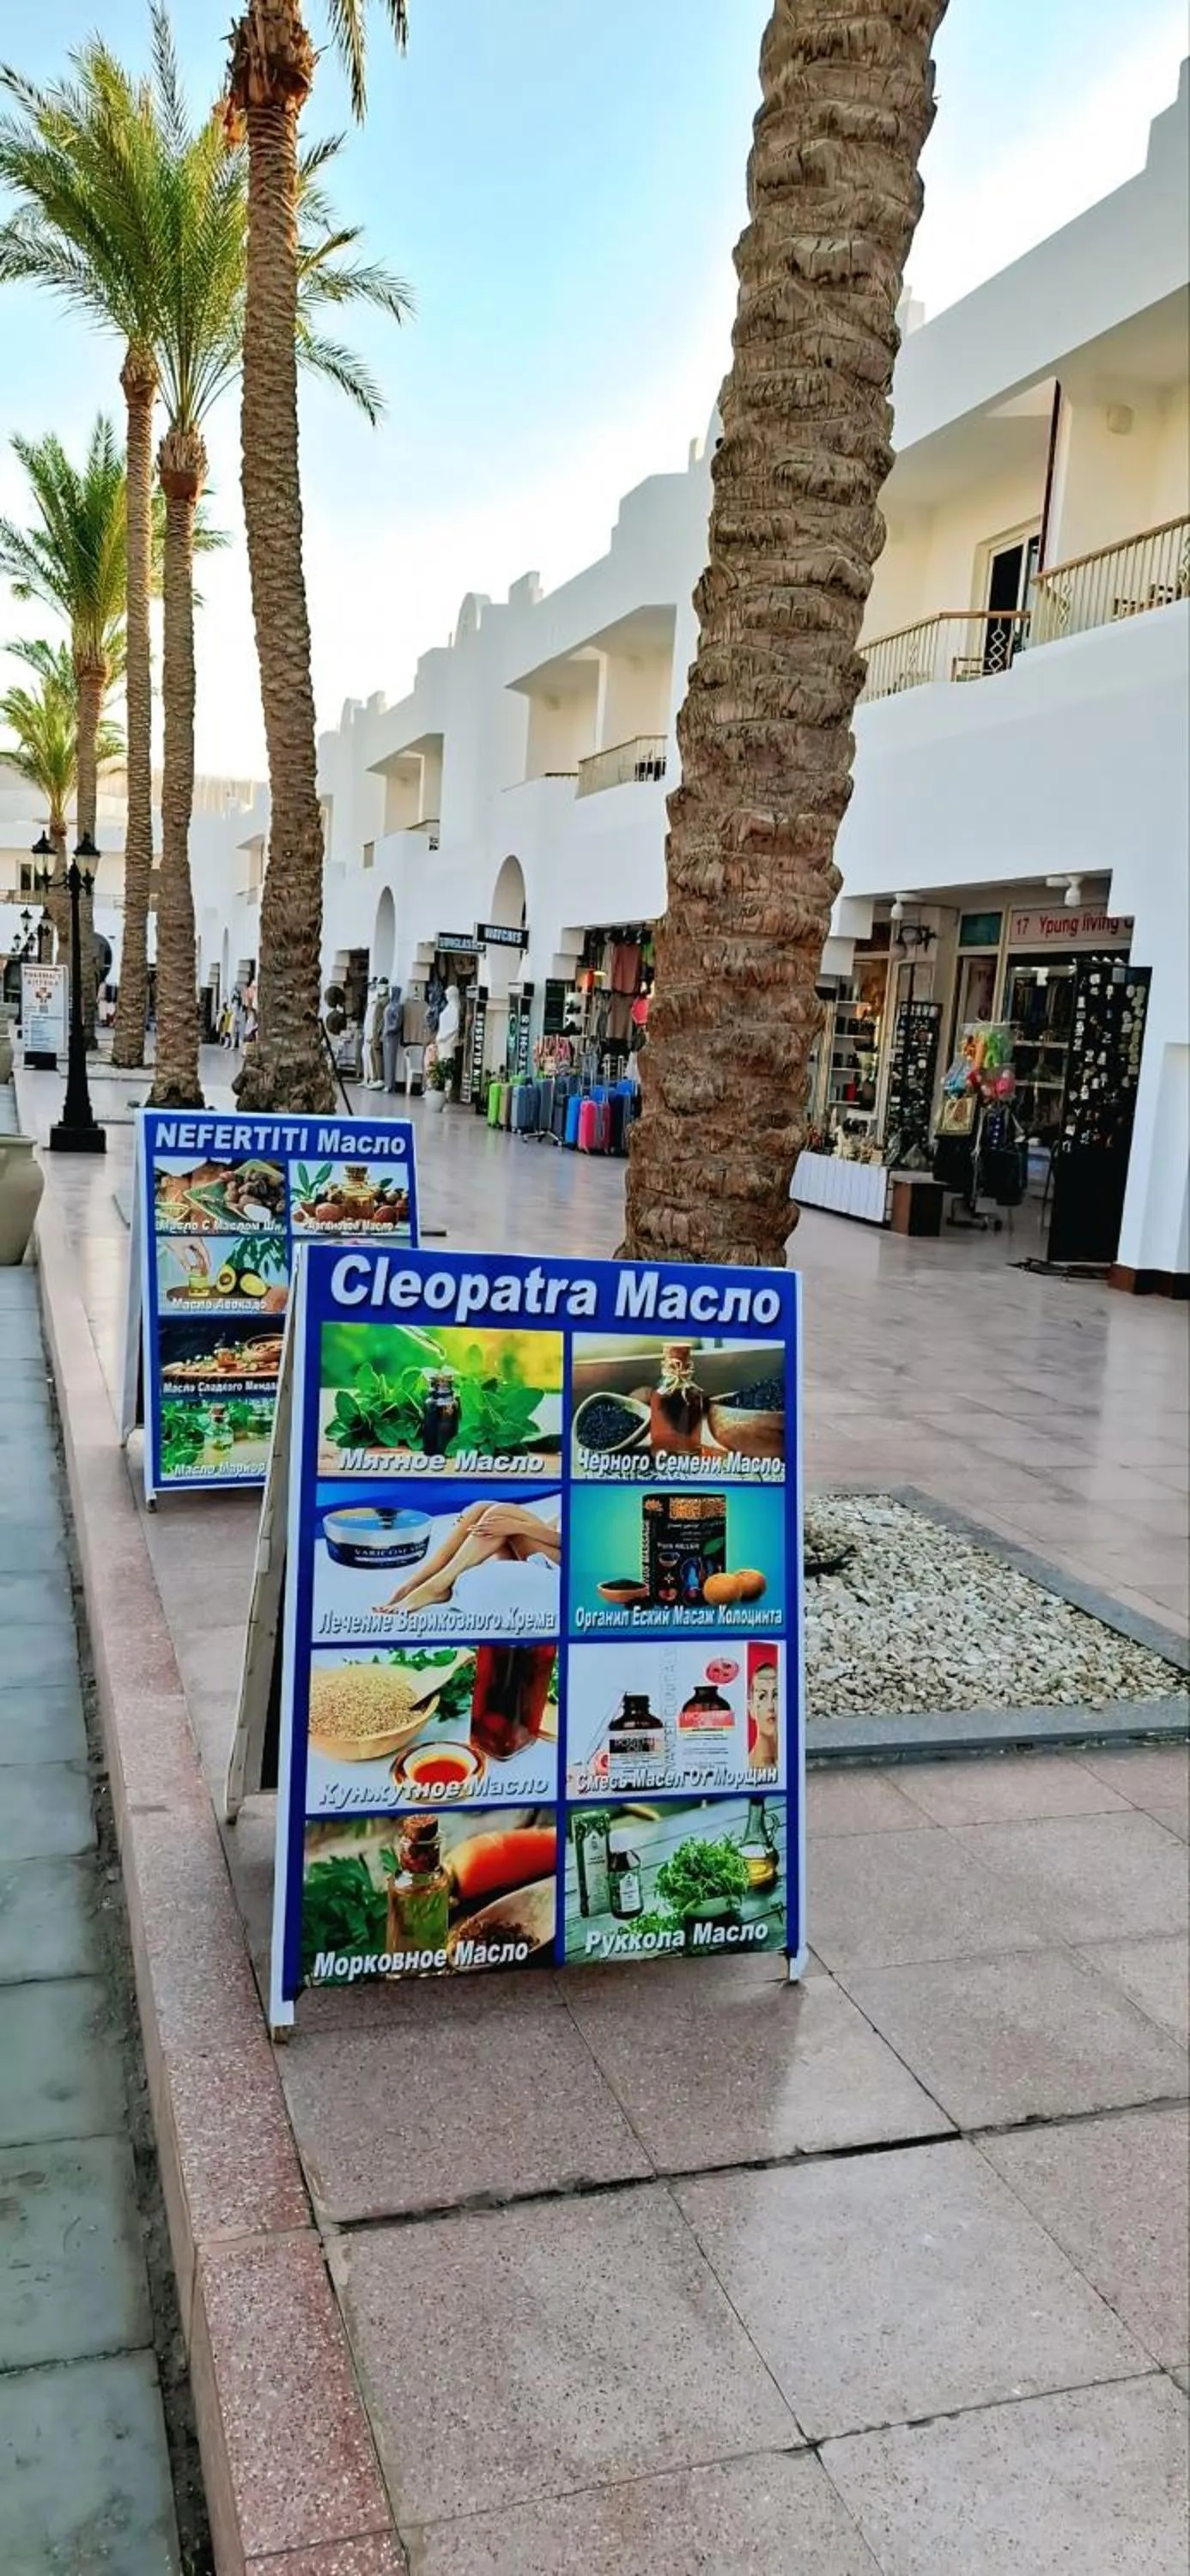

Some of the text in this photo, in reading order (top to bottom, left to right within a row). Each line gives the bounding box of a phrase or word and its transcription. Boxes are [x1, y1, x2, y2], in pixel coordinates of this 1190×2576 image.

[484, 927, 523, 945] WATCHES
[1016, 917, 1029, 935] 17
[1082, 913, 1120, 935] living
[519, 1013, 530, 1074] ATCHES
[155, 1122, 407, 1156] NEFERTITI Масло
[330, 1254, 780, 1324] Cleopatra Масло
[173, 1297, 268, 1311] Масло Авокадо
[162, 1382, 196, 1393] Масло
[197, 1381, 243, 1394] Сладкого
[174, 1463, 215, 1476] Масло
[339, 1447, 546, 1473] Мятное Масло
[577, 1448, 782, 1475] Черного Семени Масло
[319, 1607, 556, 1637] Лечение Варикозного Крема
[672, 1606, 715, 1626] Масаж
[319, 1777, 549, 1809] Кунжутное Масло
[577, 1773, 628, 1794] Смесь
[632, 1768, 686, 1789] Масел
[713, 1766, 779, 1789] Морщин
[584, 1922, 768, 1959] Руккола Масло
[313, 1939, 529, 1982] Морковное Масло
